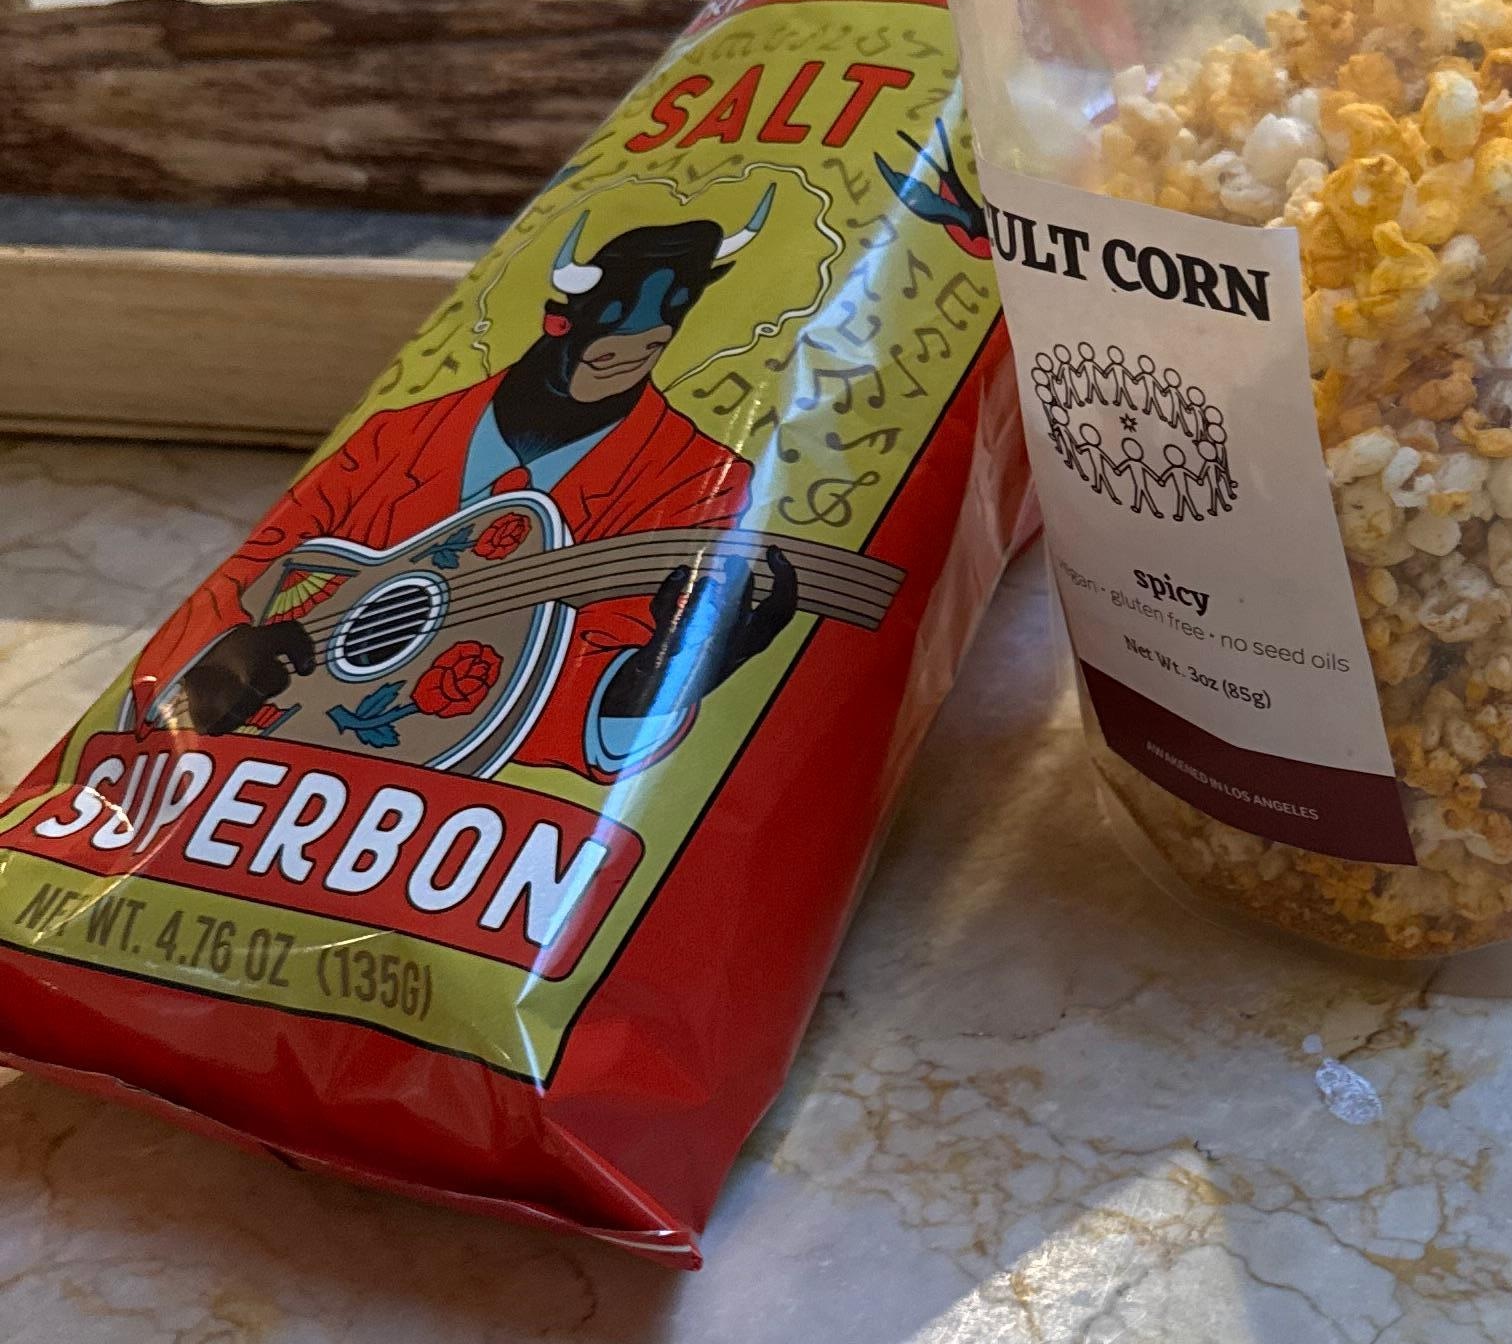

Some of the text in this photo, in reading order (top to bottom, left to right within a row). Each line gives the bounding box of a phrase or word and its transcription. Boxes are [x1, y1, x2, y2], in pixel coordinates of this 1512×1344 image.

[624, 61, 915, 152] SALT
[983, 196, 1271, 322] ULT CORN
[1110, 589, 1165, 624] gluten
[1166, 612, 1205, 641] free
[1220, 632, 1248, 652] no
[1252, 639, 1305, 666] seed
[1311, 651, 1351, 674] oils
[1132, 567, 1210, 617] spicy
[1123, 635, 1153, 661] Net
[1189, 666, 1219, 692] 3oz
[1222, 679, 1272, 710] (85g)
[1224, 783, 1251, 804] LOS
[1253, 794, 1320, 821] ANGELES
[34, 751, 608, 946] SUPERBON
[154, 909, 235, 974] 4.76
[243, 925, 297, 989] OZ
[315, 944, 437, 1022] (135G)
